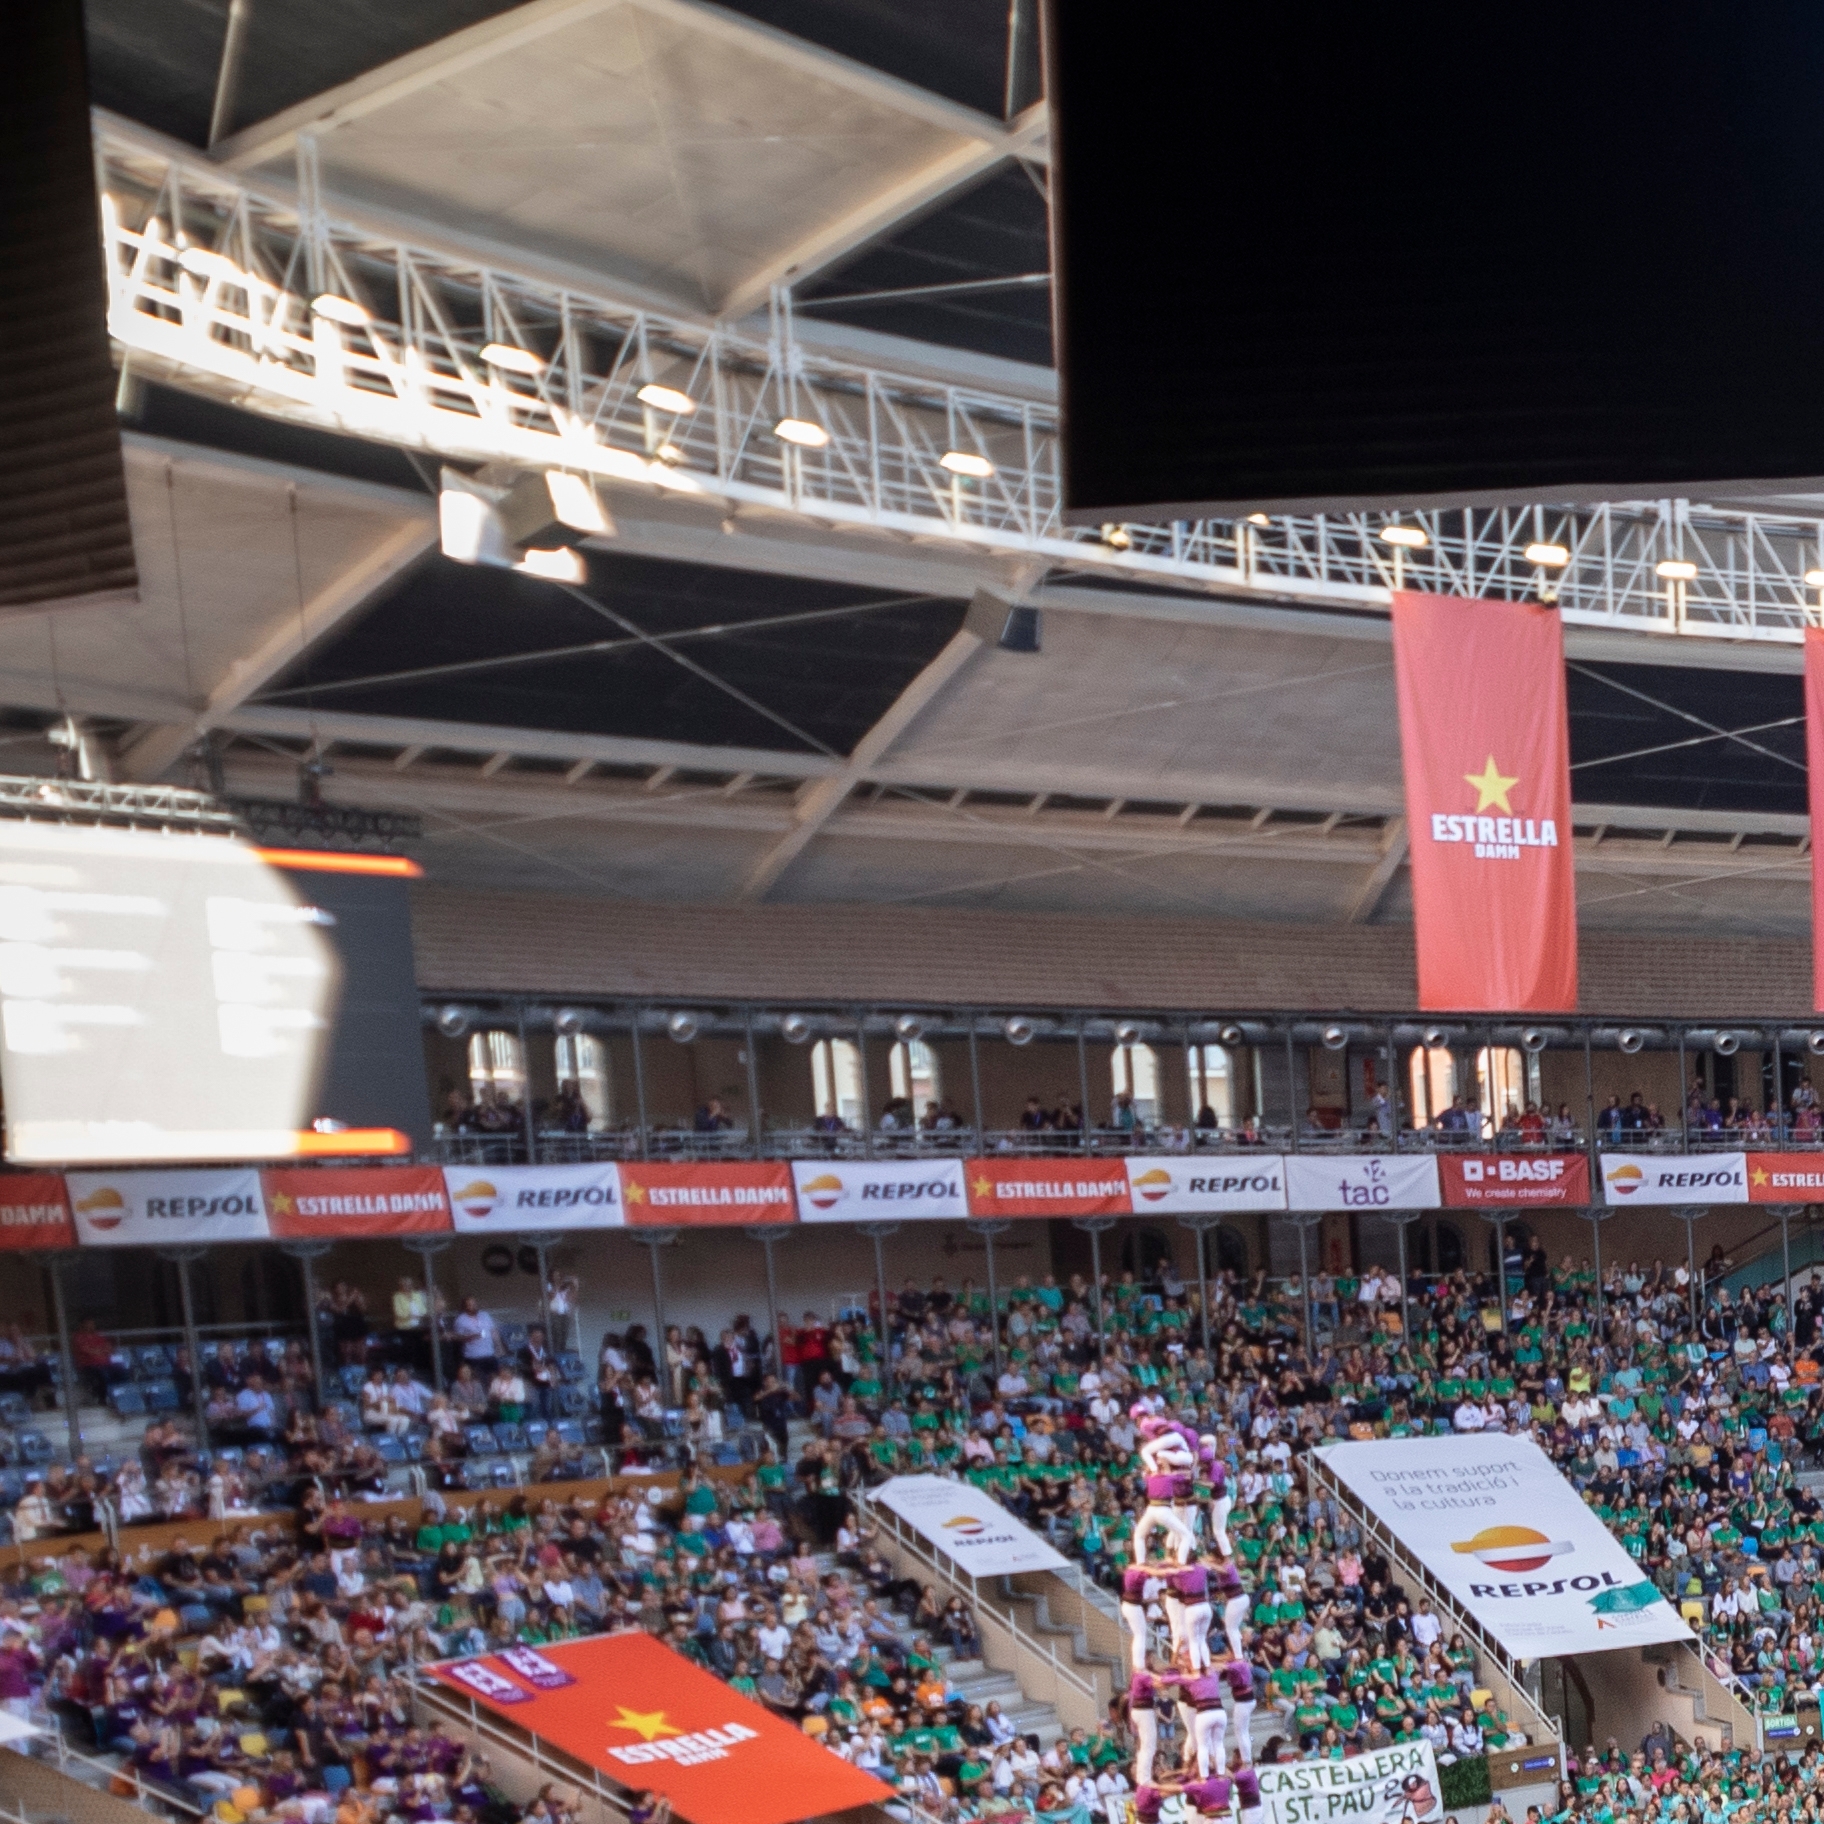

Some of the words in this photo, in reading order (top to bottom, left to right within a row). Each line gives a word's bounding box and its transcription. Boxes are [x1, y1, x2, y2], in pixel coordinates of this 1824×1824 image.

[1432, 812, 1558, 848] ESTRELLA
[1474, 843, 1520, 860] DAMM
[1499, 1160, 1564, 1181] BASF
[1658, 1170, 1744, 1188] REPSOL
[861, 1181, 960, 1200] REPSOL
[996, 1180, 1073, 1198] ESTRELLA
[1075, 1179, 1126, 1196] DAMM
[1190, 1173, 1281, 1193] REPSOL
[1338, 1179, 1390, 1205] tac
[296, 1196, 387, 1216] ESTRELLA
[390, 1192, 443, 1214] DAMM
[517, 1186, 617, 1208] REPSOL
[649, 1187, 730, 1205] ESTRELLA
[733, 1186, 788, 1204] DAMM
[1465, 1187, 1487, 1199] We
[1488, 1189, 1516, 1199] create
[1518, 1187, 1567, 1201] chemistry
[146, 1197, 258, 1220] REPSOL
[1371, 1467, 1448, 1482] Donem
[1452, 1461, 1521, 1480] suport
[1401, 1482, 1422, 1496] la
[1426, 1477, 1508, 1494] tradició
[1392, 1498, 1416, 1511] la
[1420, 1495, 1496, 1511] cultura
[1469, 1572, 1622, 1597] REPSOL
[606, 1722, 760, 1765] ESTRELLA
[1258, 1748, 1425, 1795] CASTELLERA
[1286, 1797, 1319, 1822] ST.
[1328, 1787, 1375, 1818] PAU
